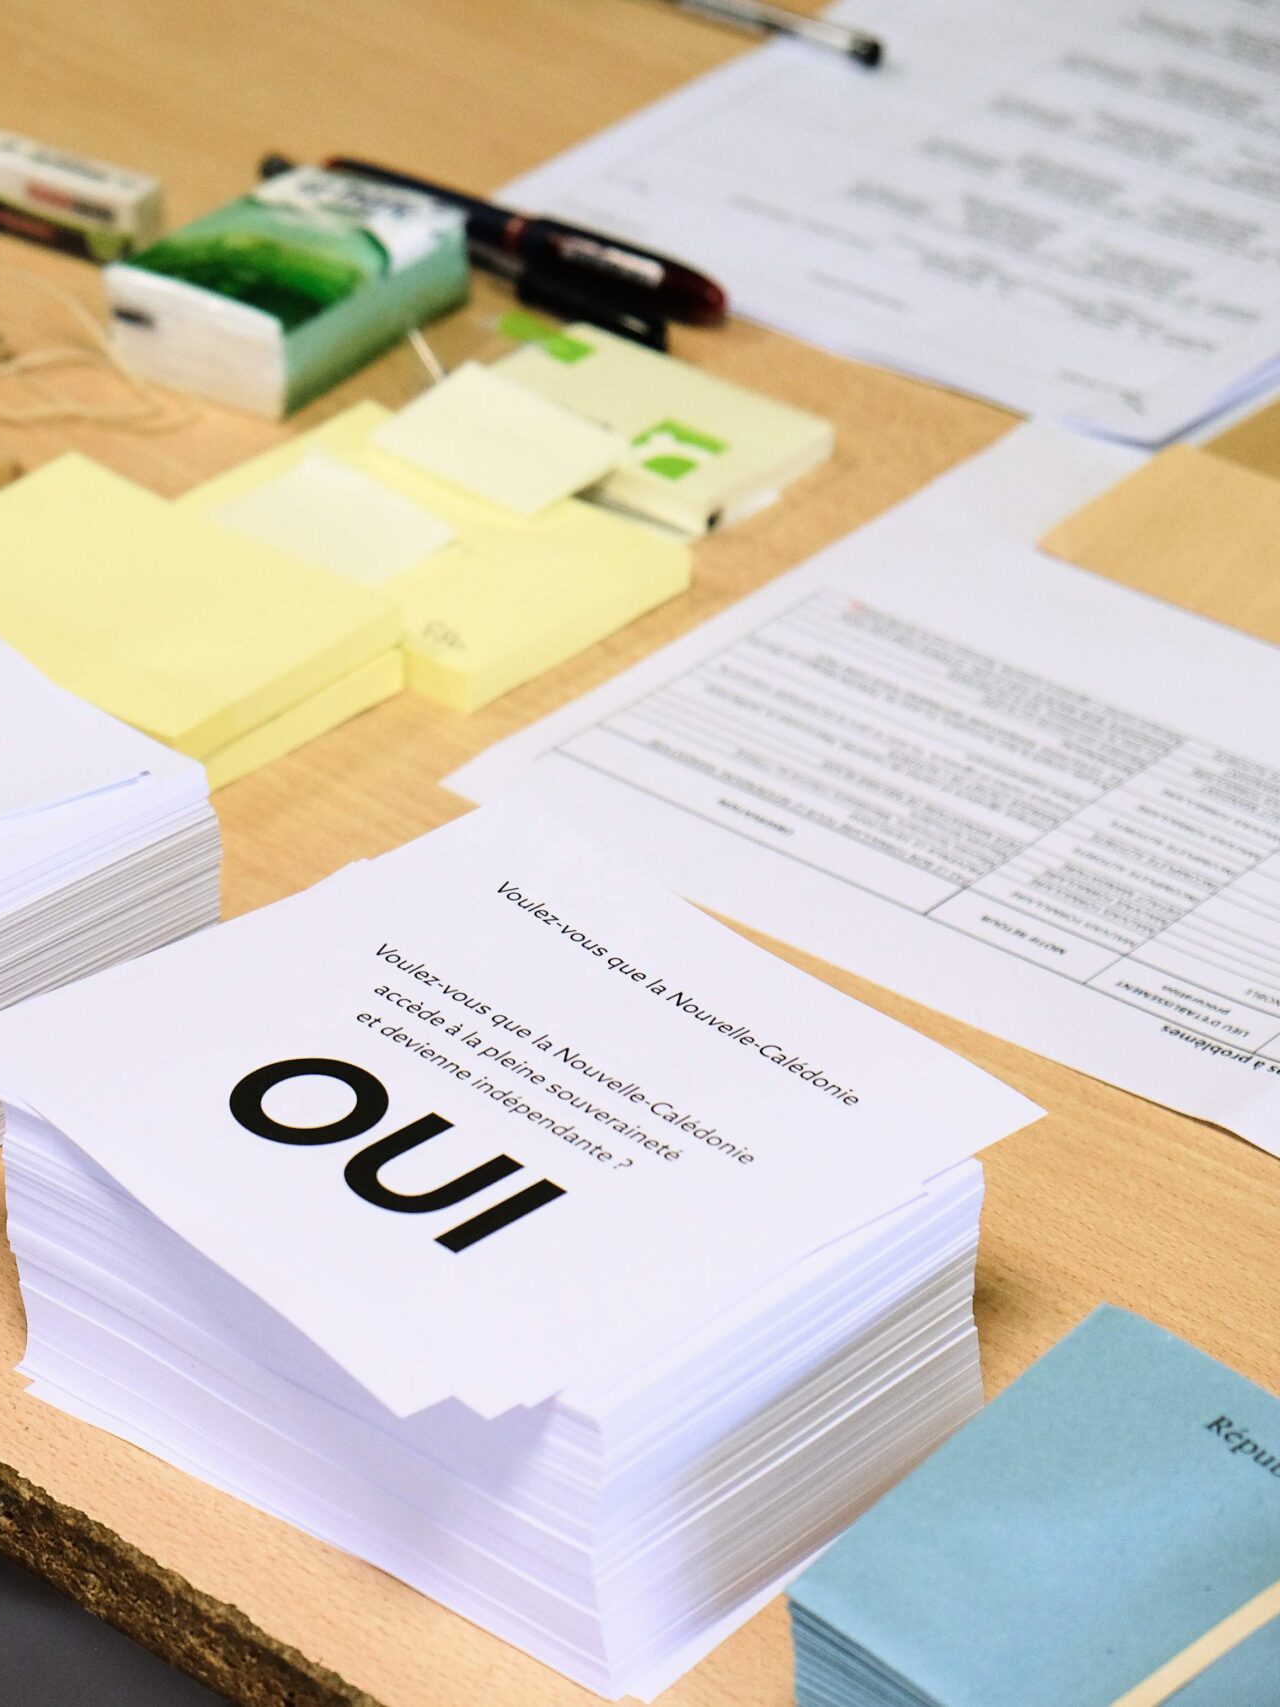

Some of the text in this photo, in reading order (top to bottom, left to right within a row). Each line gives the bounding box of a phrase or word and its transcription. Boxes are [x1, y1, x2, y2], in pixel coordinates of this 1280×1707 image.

[374, 984, 683, 1162] accède à la pleine souveraineté
[375, 943, 754, 1165] Voulez-vous que la Nouvelle-Calédonie
[497, 881, 859, 1106] Voulez-vous que la Nouvelle-Calédonie
[1161, 1025, 1254, 1063] problèmes
[229, 1057, 568, 1253] OUI
[356, 1012, 634, 1170] et devienne indépendante ?
